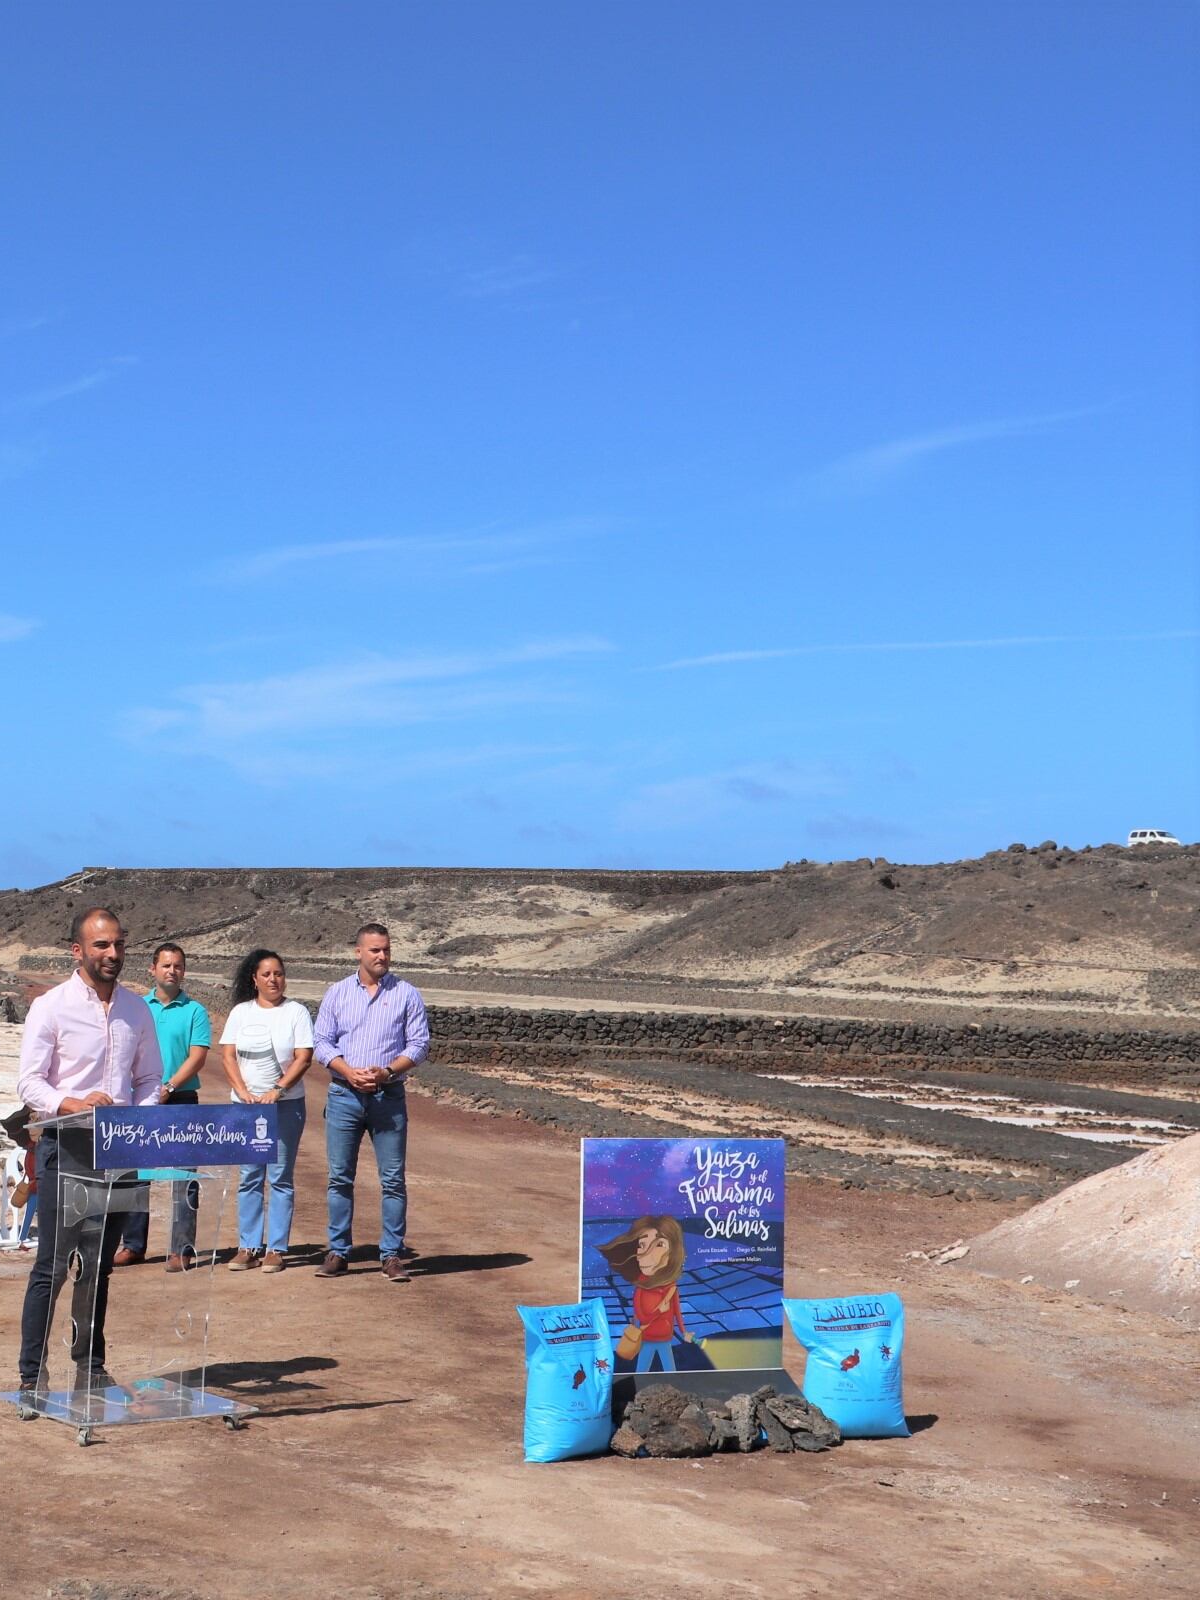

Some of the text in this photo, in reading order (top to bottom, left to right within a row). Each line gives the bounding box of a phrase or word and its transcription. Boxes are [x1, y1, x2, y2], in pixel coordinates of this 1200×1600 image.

[100, 1121, 147, 1151] Yaiza
[150, 1124, 203, 1149] Fantasma
[187, 1122, 195, 1131] de
[205, 1122, 247, 1146] Salinas
[694, 1146, 760, 1187] Yaiza
[749, 1169, 768, 1185] y el
[678, 1171, 775, 1215] Fantasma
[704, 1206, 770, 1241] Salinas
[738, 1204, 748, 1215] de
